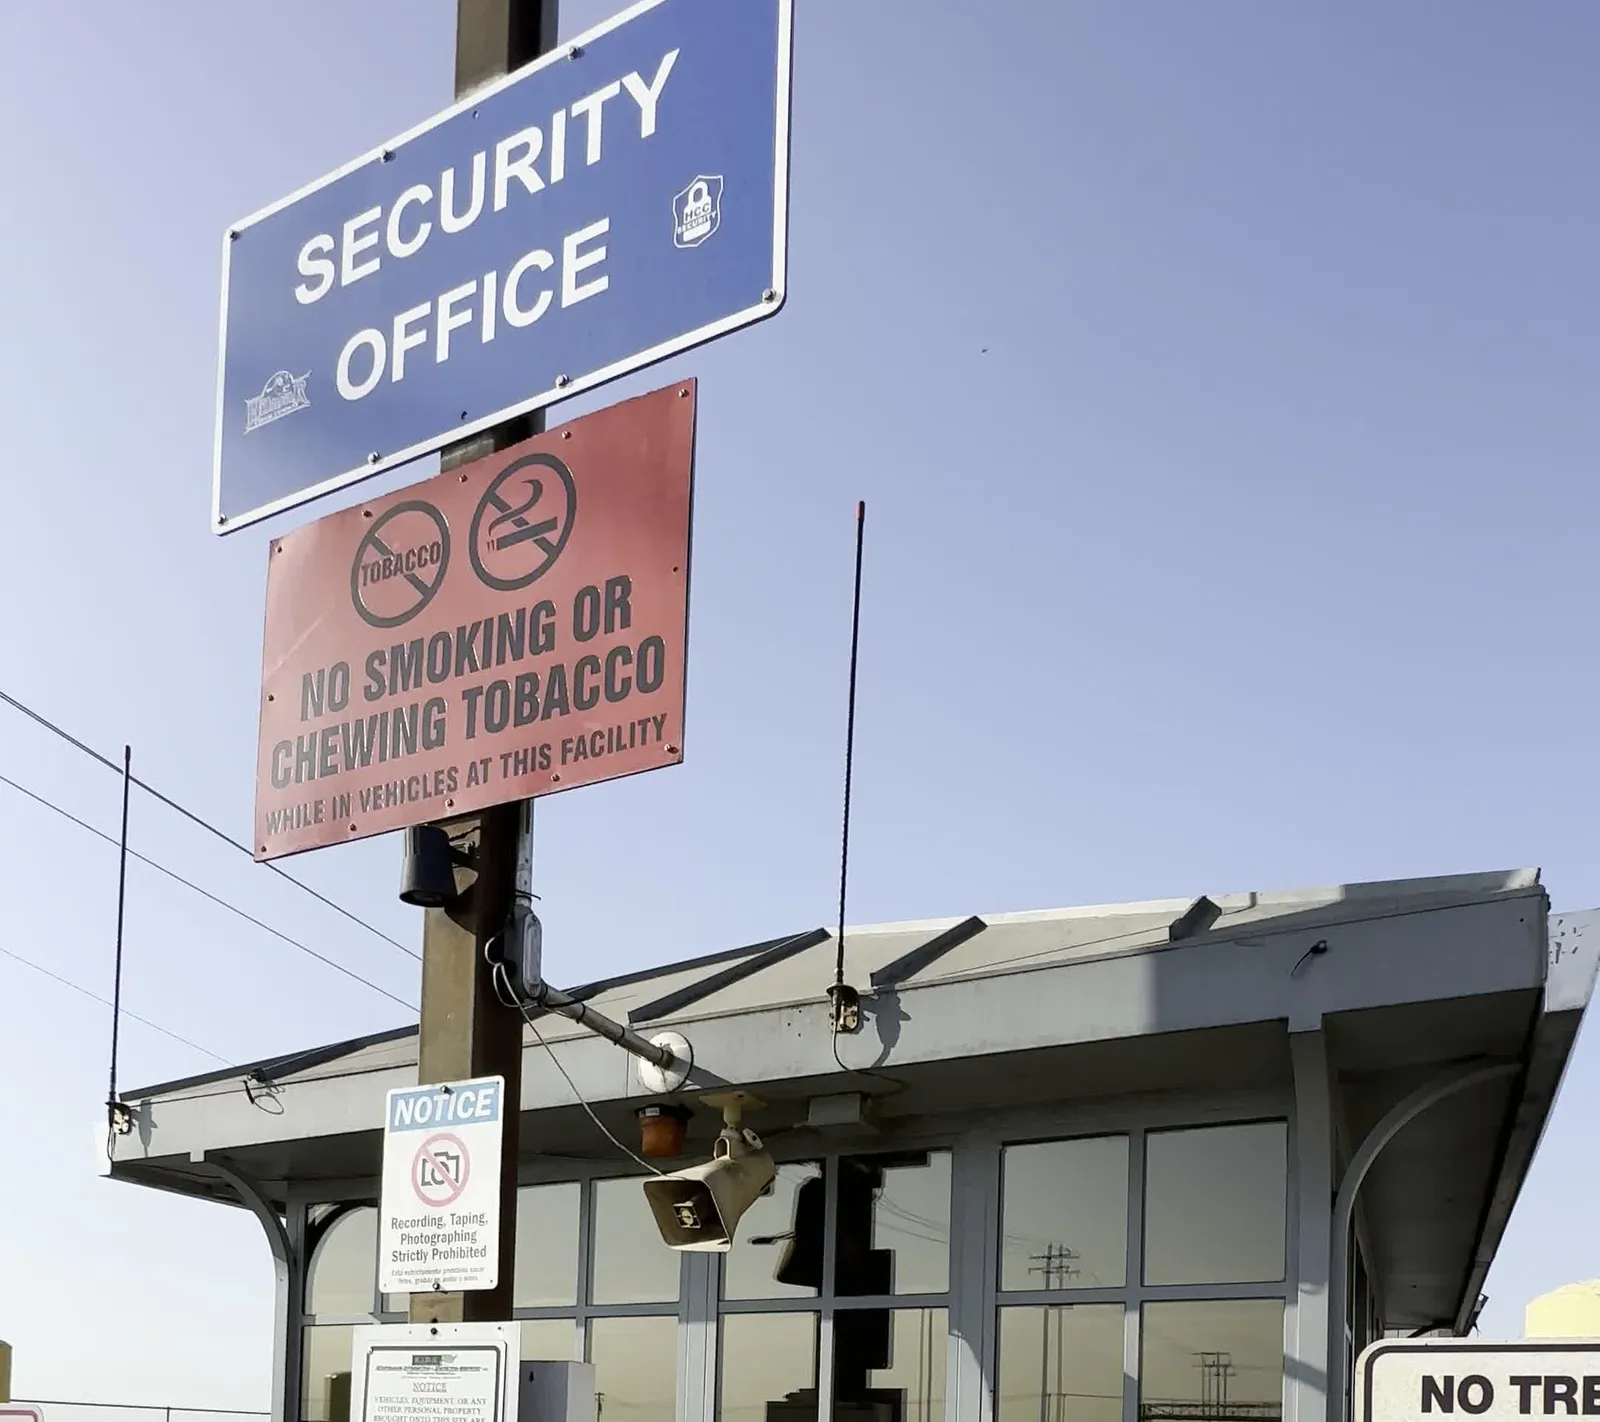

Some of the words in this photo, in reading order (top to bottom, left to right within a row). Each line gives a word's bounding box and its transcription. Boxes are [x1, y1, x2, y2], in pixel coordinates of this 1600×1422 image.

[294, 47, 681, 307] SECURITY
[335, 217, 611, 402] OFFICE
[360, 540, 442, 588] TOBACCO
[300, 660, 350, 721] NO
[363, 599, 557, 702] SMOKING
[572, 574, 632, 643] OR
[271, 695, 447, 790] CHEWING
[462, 635, 665, 741] TOBACCO
[266, 799, 325, 836] WHILE
[332, 792, 352, 818] IN
[358, 767, 458, 814] VEHICLES
[466, 756, 490, 789] AT
[499, 743, 552, 779] THIS
[559, 713, 668, 767] FACILITY
[394, 1087, 495, 1127] NOTICE
[391, 1215, 446, 1229] Recording,
[450, 1212, 488, 1227] Taping,
[400, 1229, 477, 1246] Photographing
[391, 1249, 428, 1264] Strictly
[432, 1245, 487, 1260] Prohibited
[413, 1382, 447, 1393] NOTICE
[1421, 1374, 1494, 1414] NO
[1509, 1375, 1600, 1416] TRE
